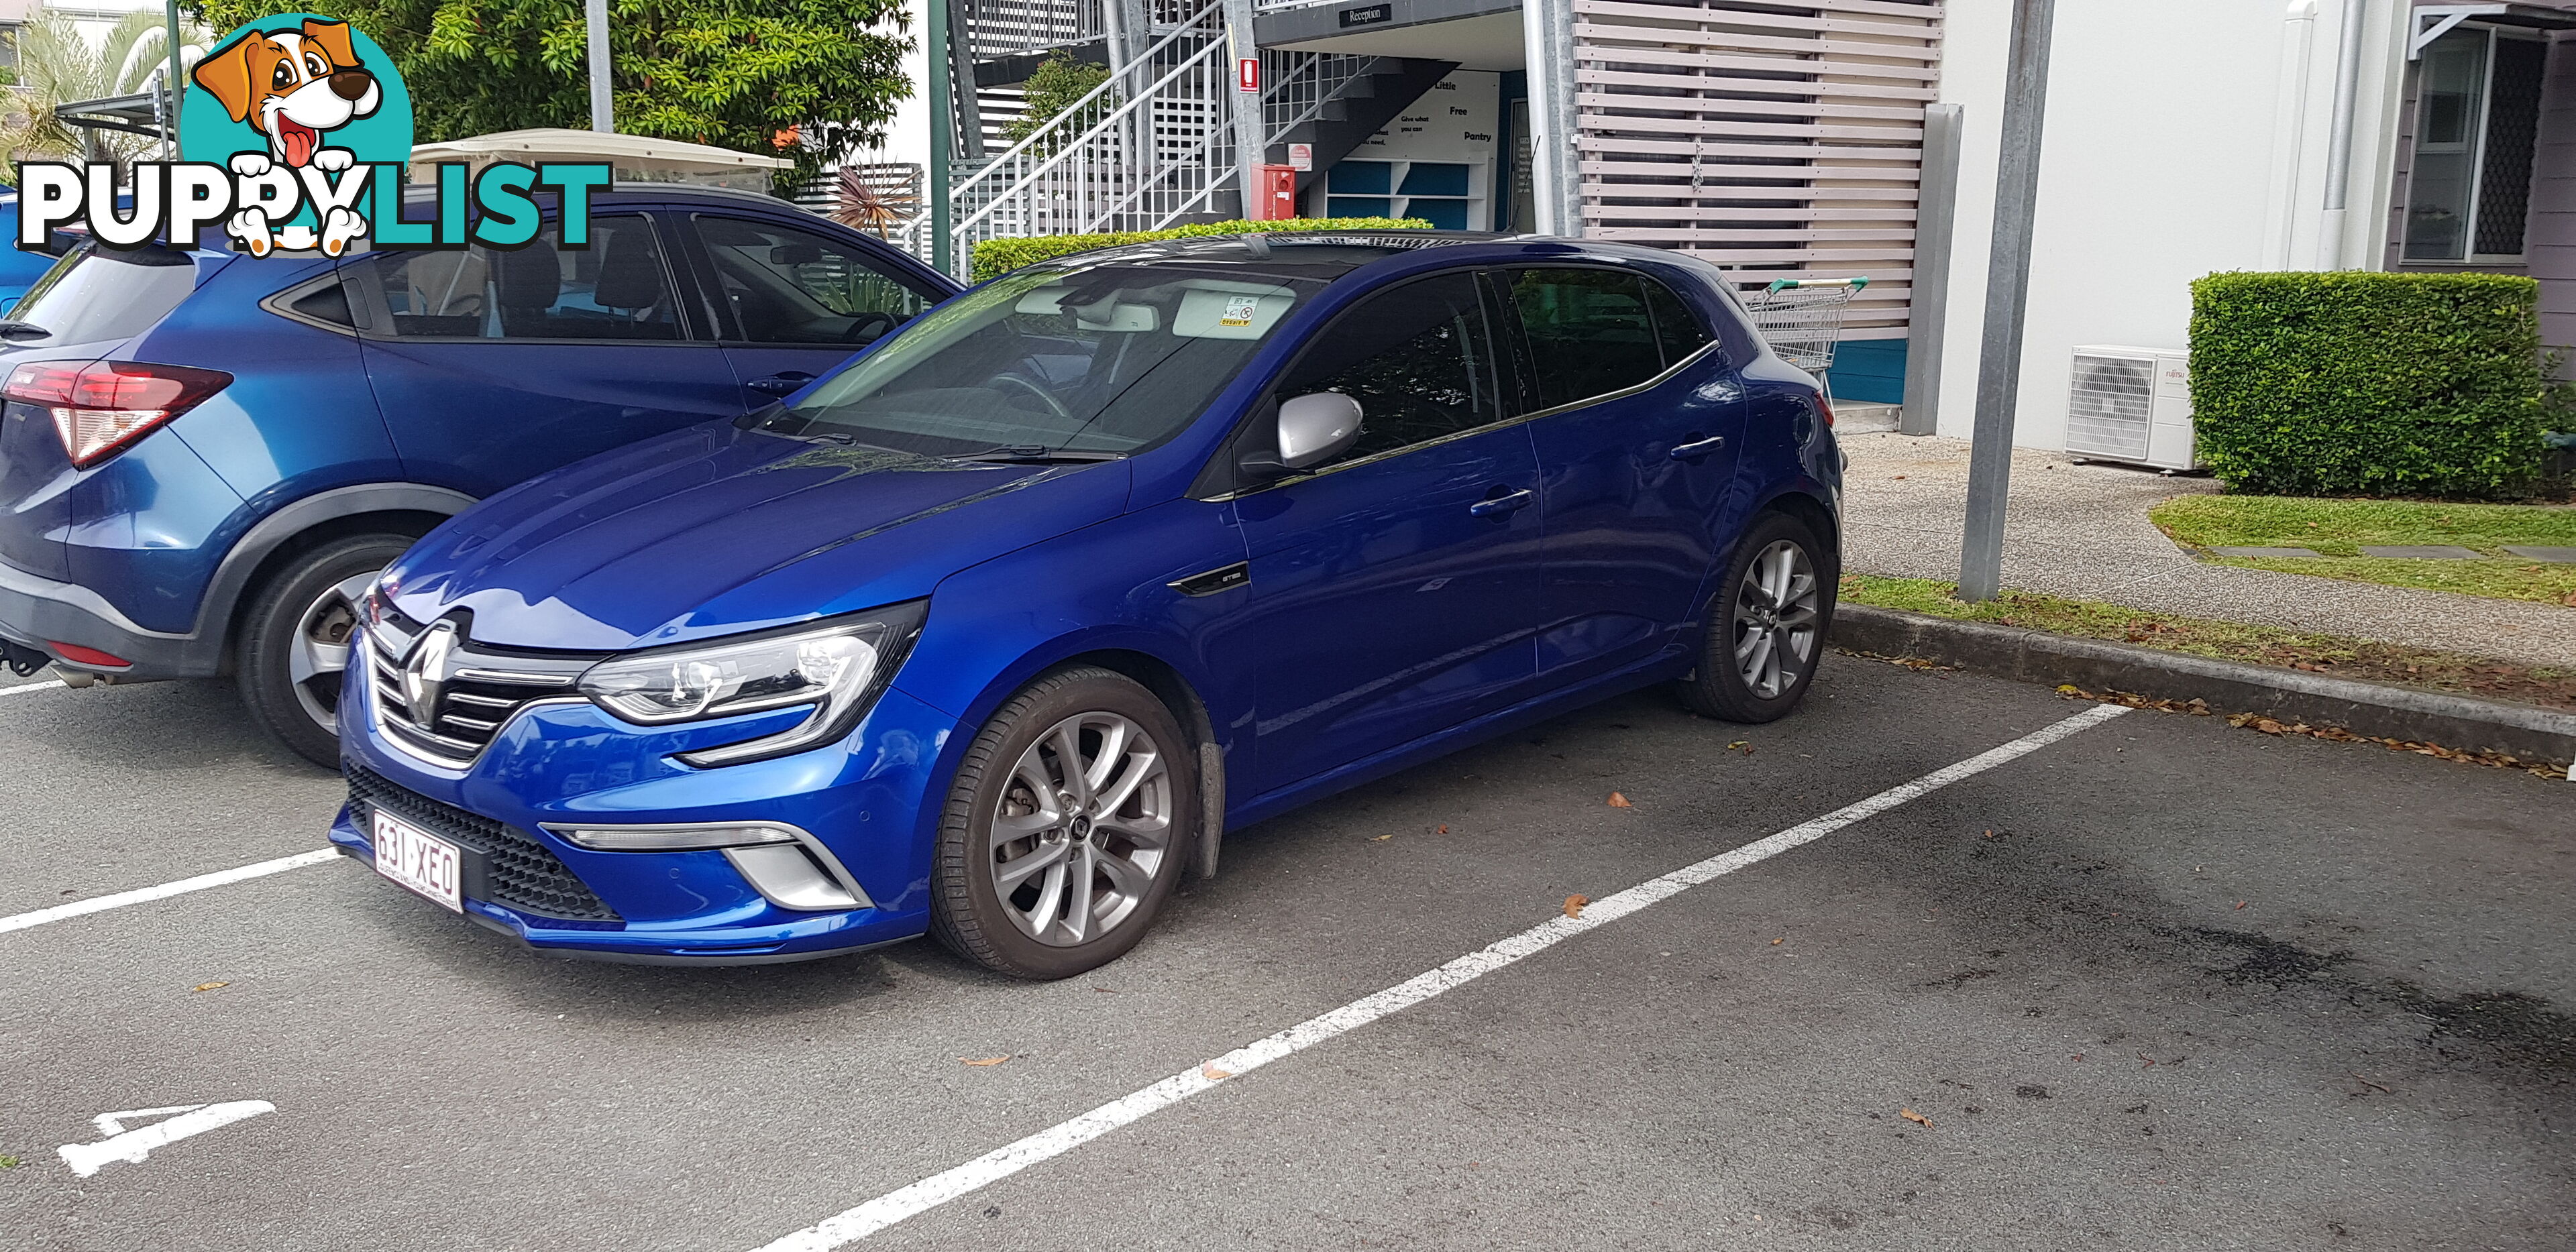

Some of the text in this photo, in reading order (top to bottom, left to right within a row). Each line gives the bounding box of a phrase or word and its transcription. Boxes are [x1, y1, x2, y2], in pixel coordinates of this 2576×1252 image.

[1349, 7, 1381, 22] Reception
[1435, 81, 1456, 90] Little
[1450, 107, 1467, 115] Free
[1464, 131, 1491, 142] Pantry
[378, 822, 405, 872] 631
